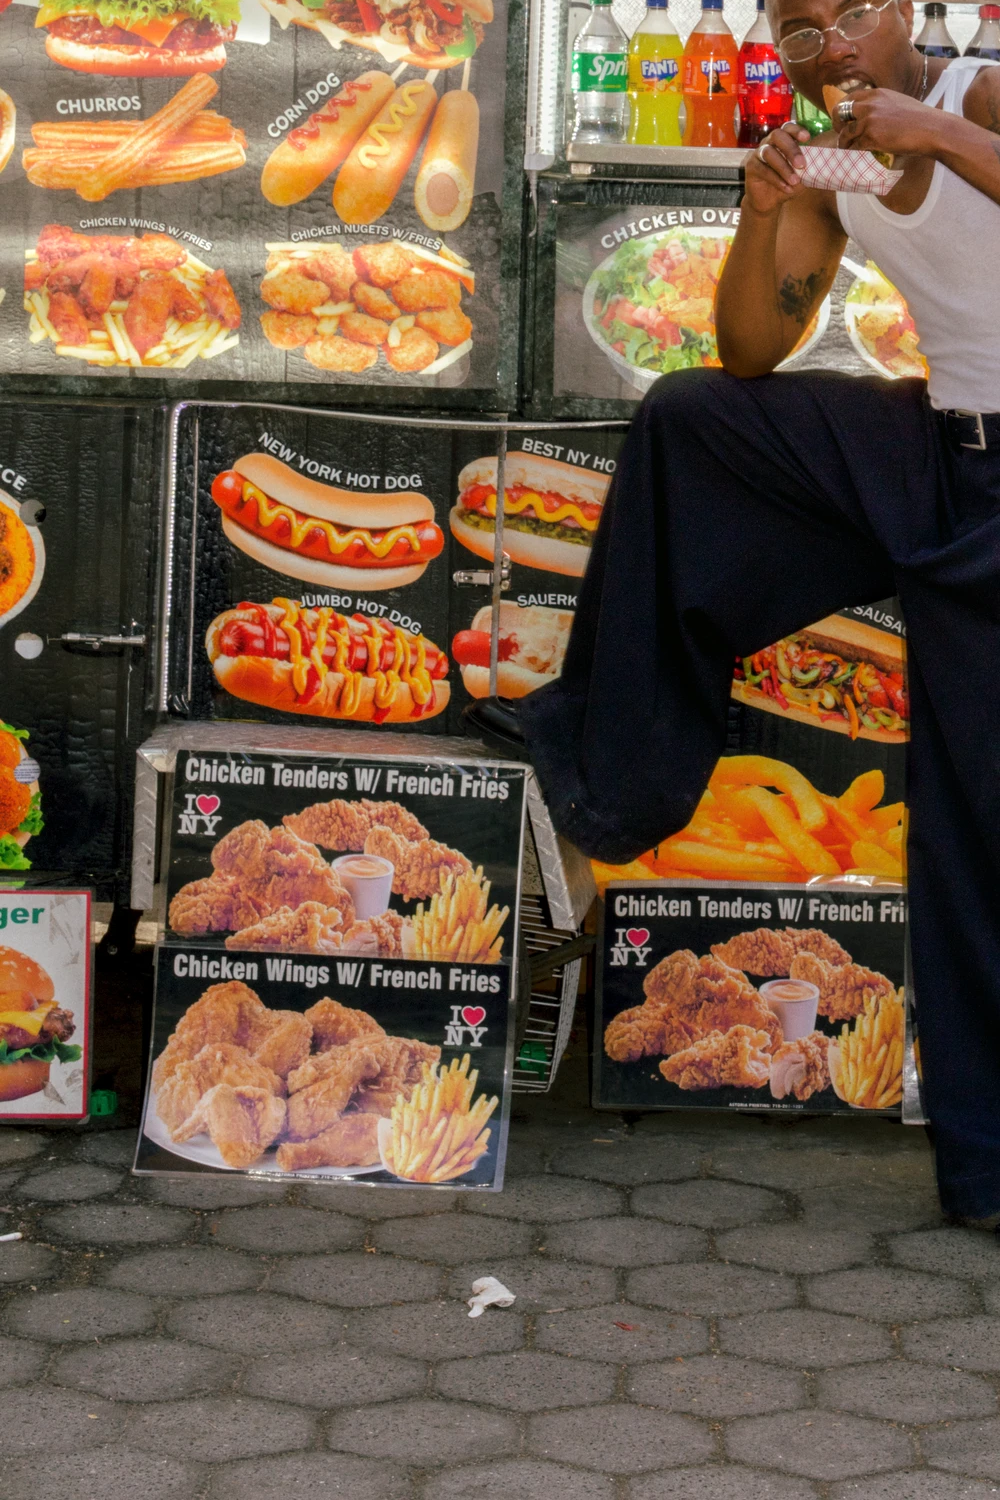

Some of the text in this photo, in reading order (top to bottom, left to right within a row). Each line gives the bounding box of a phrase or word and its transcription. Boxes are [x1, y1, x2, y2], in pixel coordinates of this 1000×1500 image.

[641, 60, 679, 76] FANTA
[701, 60, 731, 73] FANTA
[745, 61, 782, 77] FANTA
[56, 95, 142, 114] CHURROS
[267, 72, 341, 138] CORN DOG
[79, 217, 166, 232] CHICKEN WINGS
[291, 224, 389, 243] CHICKEN NUGETS
[601, 208, 694, 250] CHICKEN
[257, 431, 423, 490] NEW YORK HOT DOG
[520, 437, 593, 466] BEST NY
[299, 594, 422, 635] JUMBO HOT DOG
[185, 757, 510, 800] Chicken Tenders French Fries
[177, 814, 222, 836] NY
[614, 894, 873, 922] Chicken Tenders French
[609, 948, 652, 967] NY
[174, 953, 501, 993] Chicken Wings French Fries
[443, 1025, 488, 1047] NY
